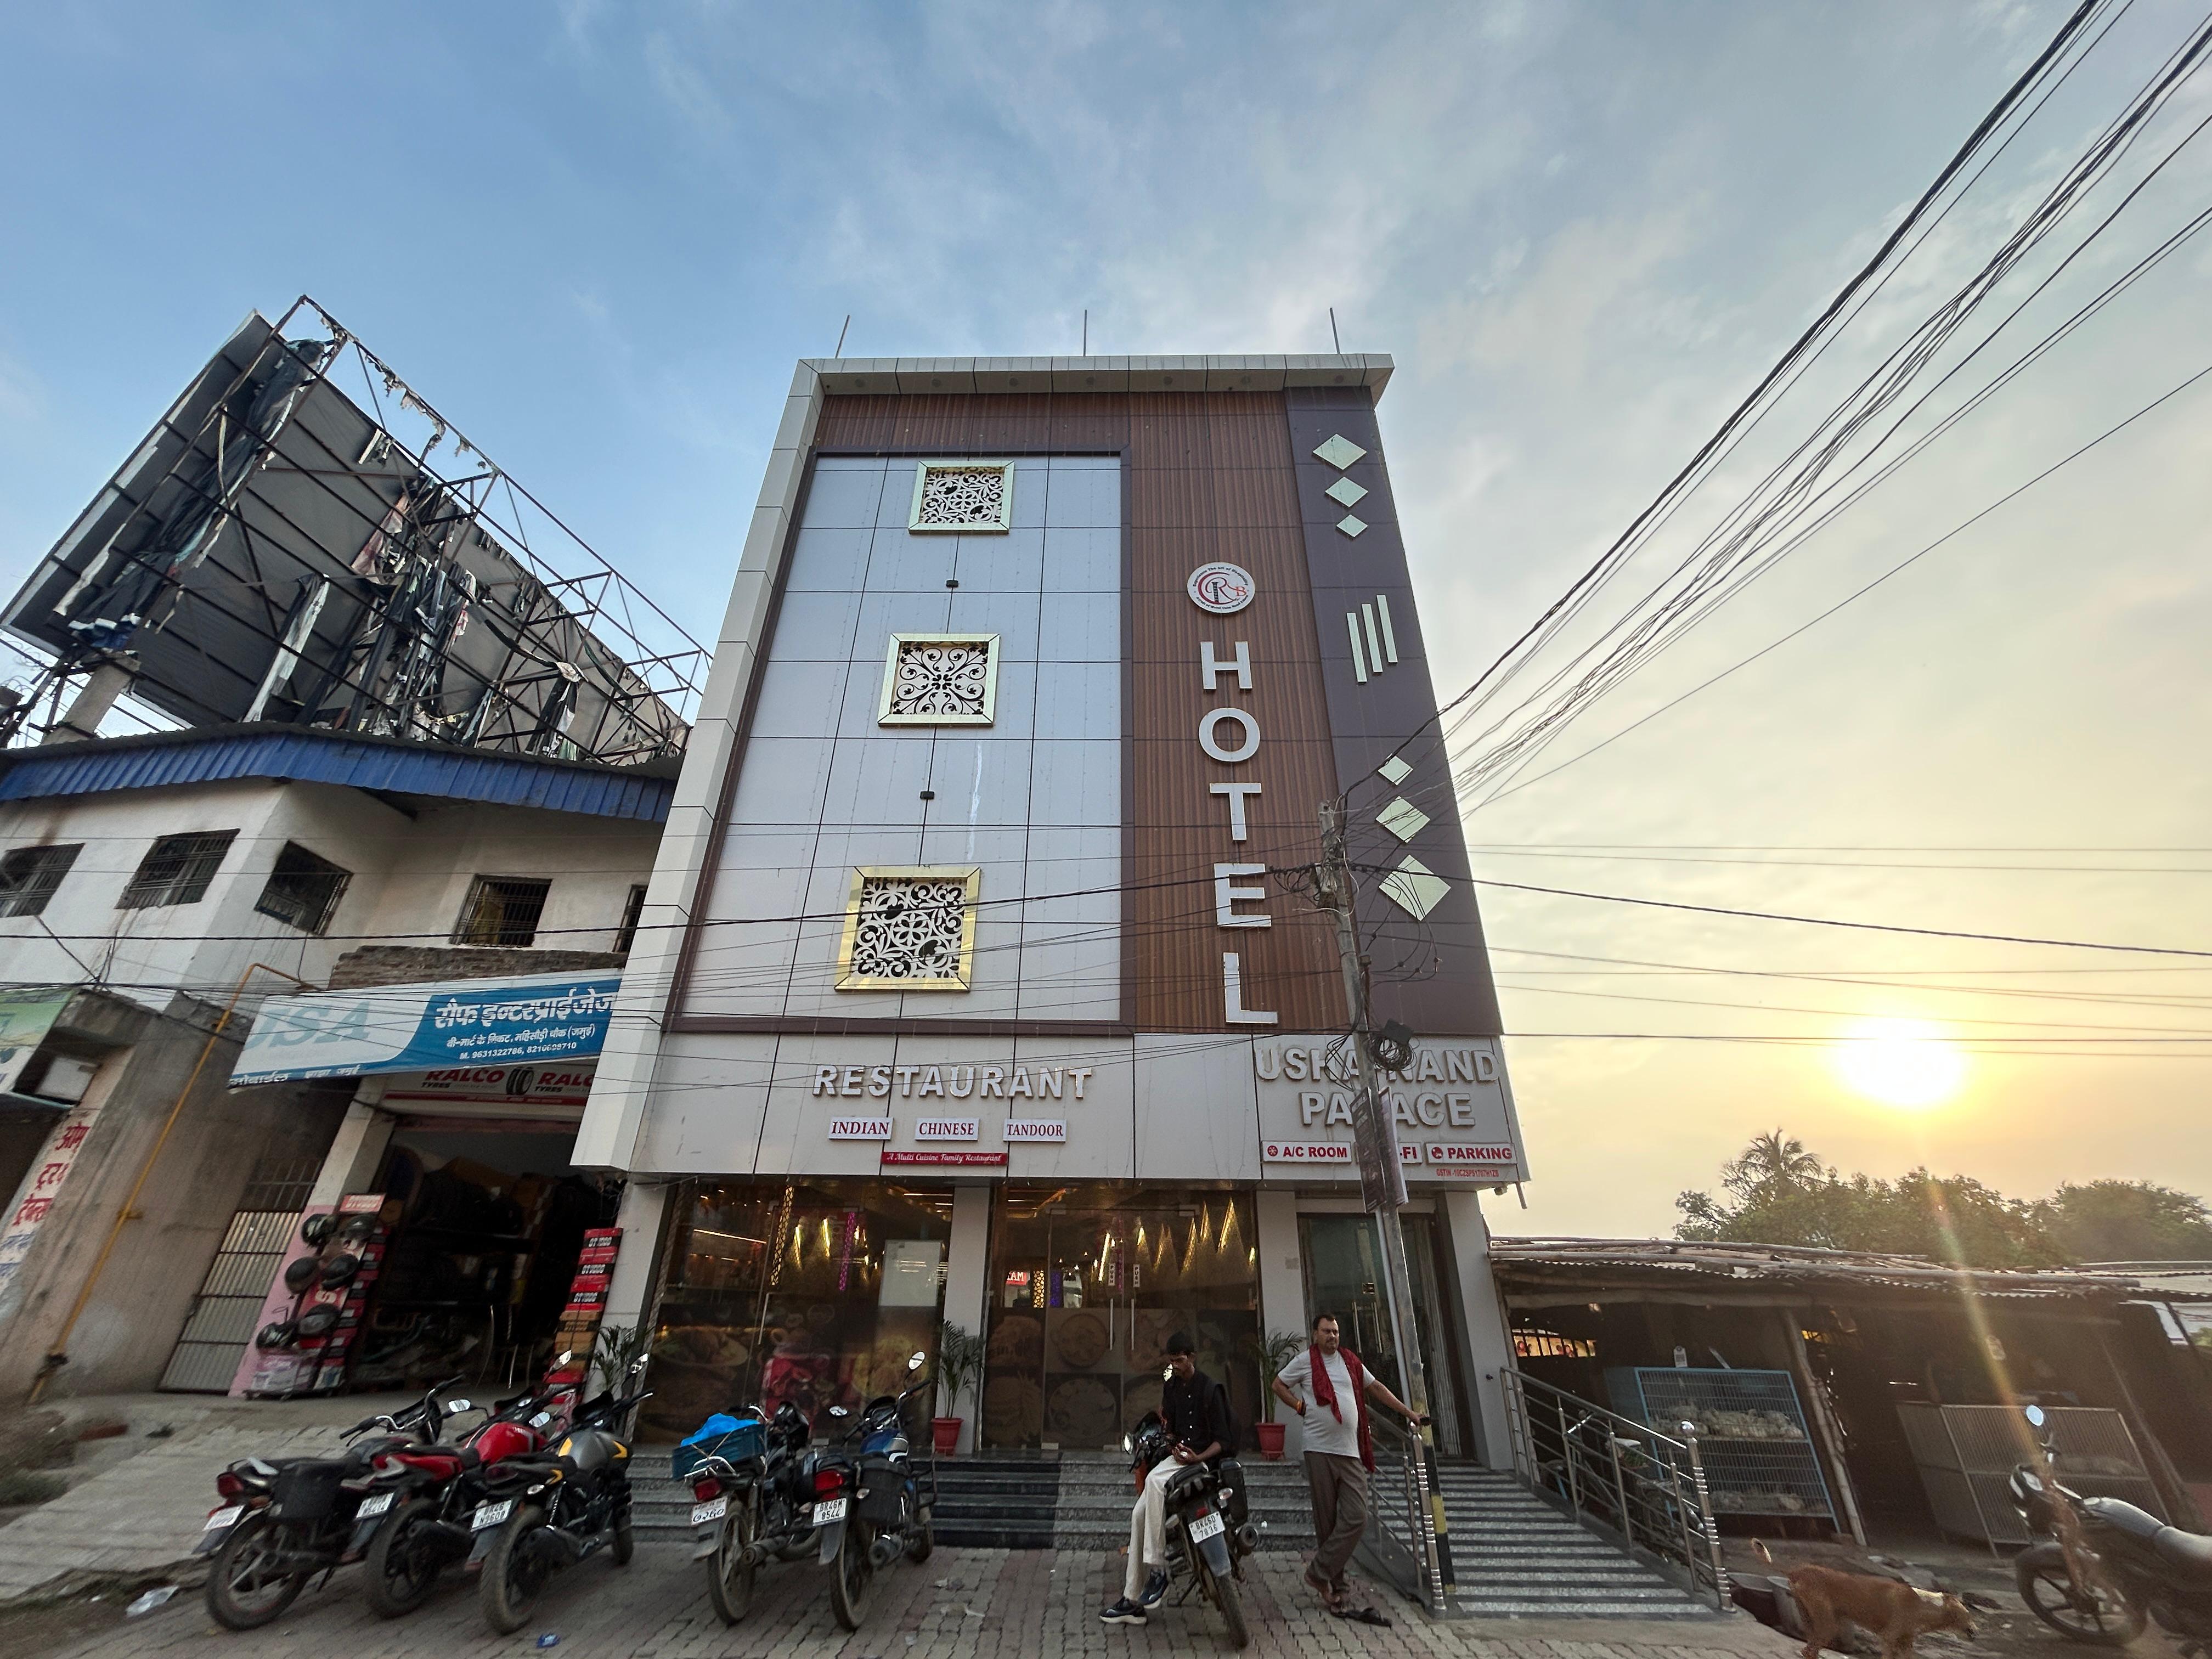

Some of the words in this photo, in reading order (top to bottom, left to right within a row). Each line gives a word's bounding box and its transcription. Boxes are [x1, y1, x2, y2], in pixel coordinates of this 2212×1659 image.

[1199, 641, 1278, 1024] HOTEL
[435, 998, 479, 1029] सैफ
[477, 1035, 486, 1045] के
[425, 1069, 506, 1084] RALCO
[538, 1071, 595, 1086] RALC
[812, 1064, 1093, 1098] RESTAURANT
[1301, 1092, 1476, 1126] PAACE
[831, 1121, 889, 1135] INDIAN
[919, 1122, 974, 1136] CHINESE
[1007, 1123, 1063, 1136] TANDOOR
[941, 1154, 963, 1164] Family
[1283, 1146, 1304, 1158] A/C
[1308, 1146, 1347, 1158] ROOM
[1447, 1147, 1513, 1159] PARKING
[821, 1509, 840, 1520] 8544
